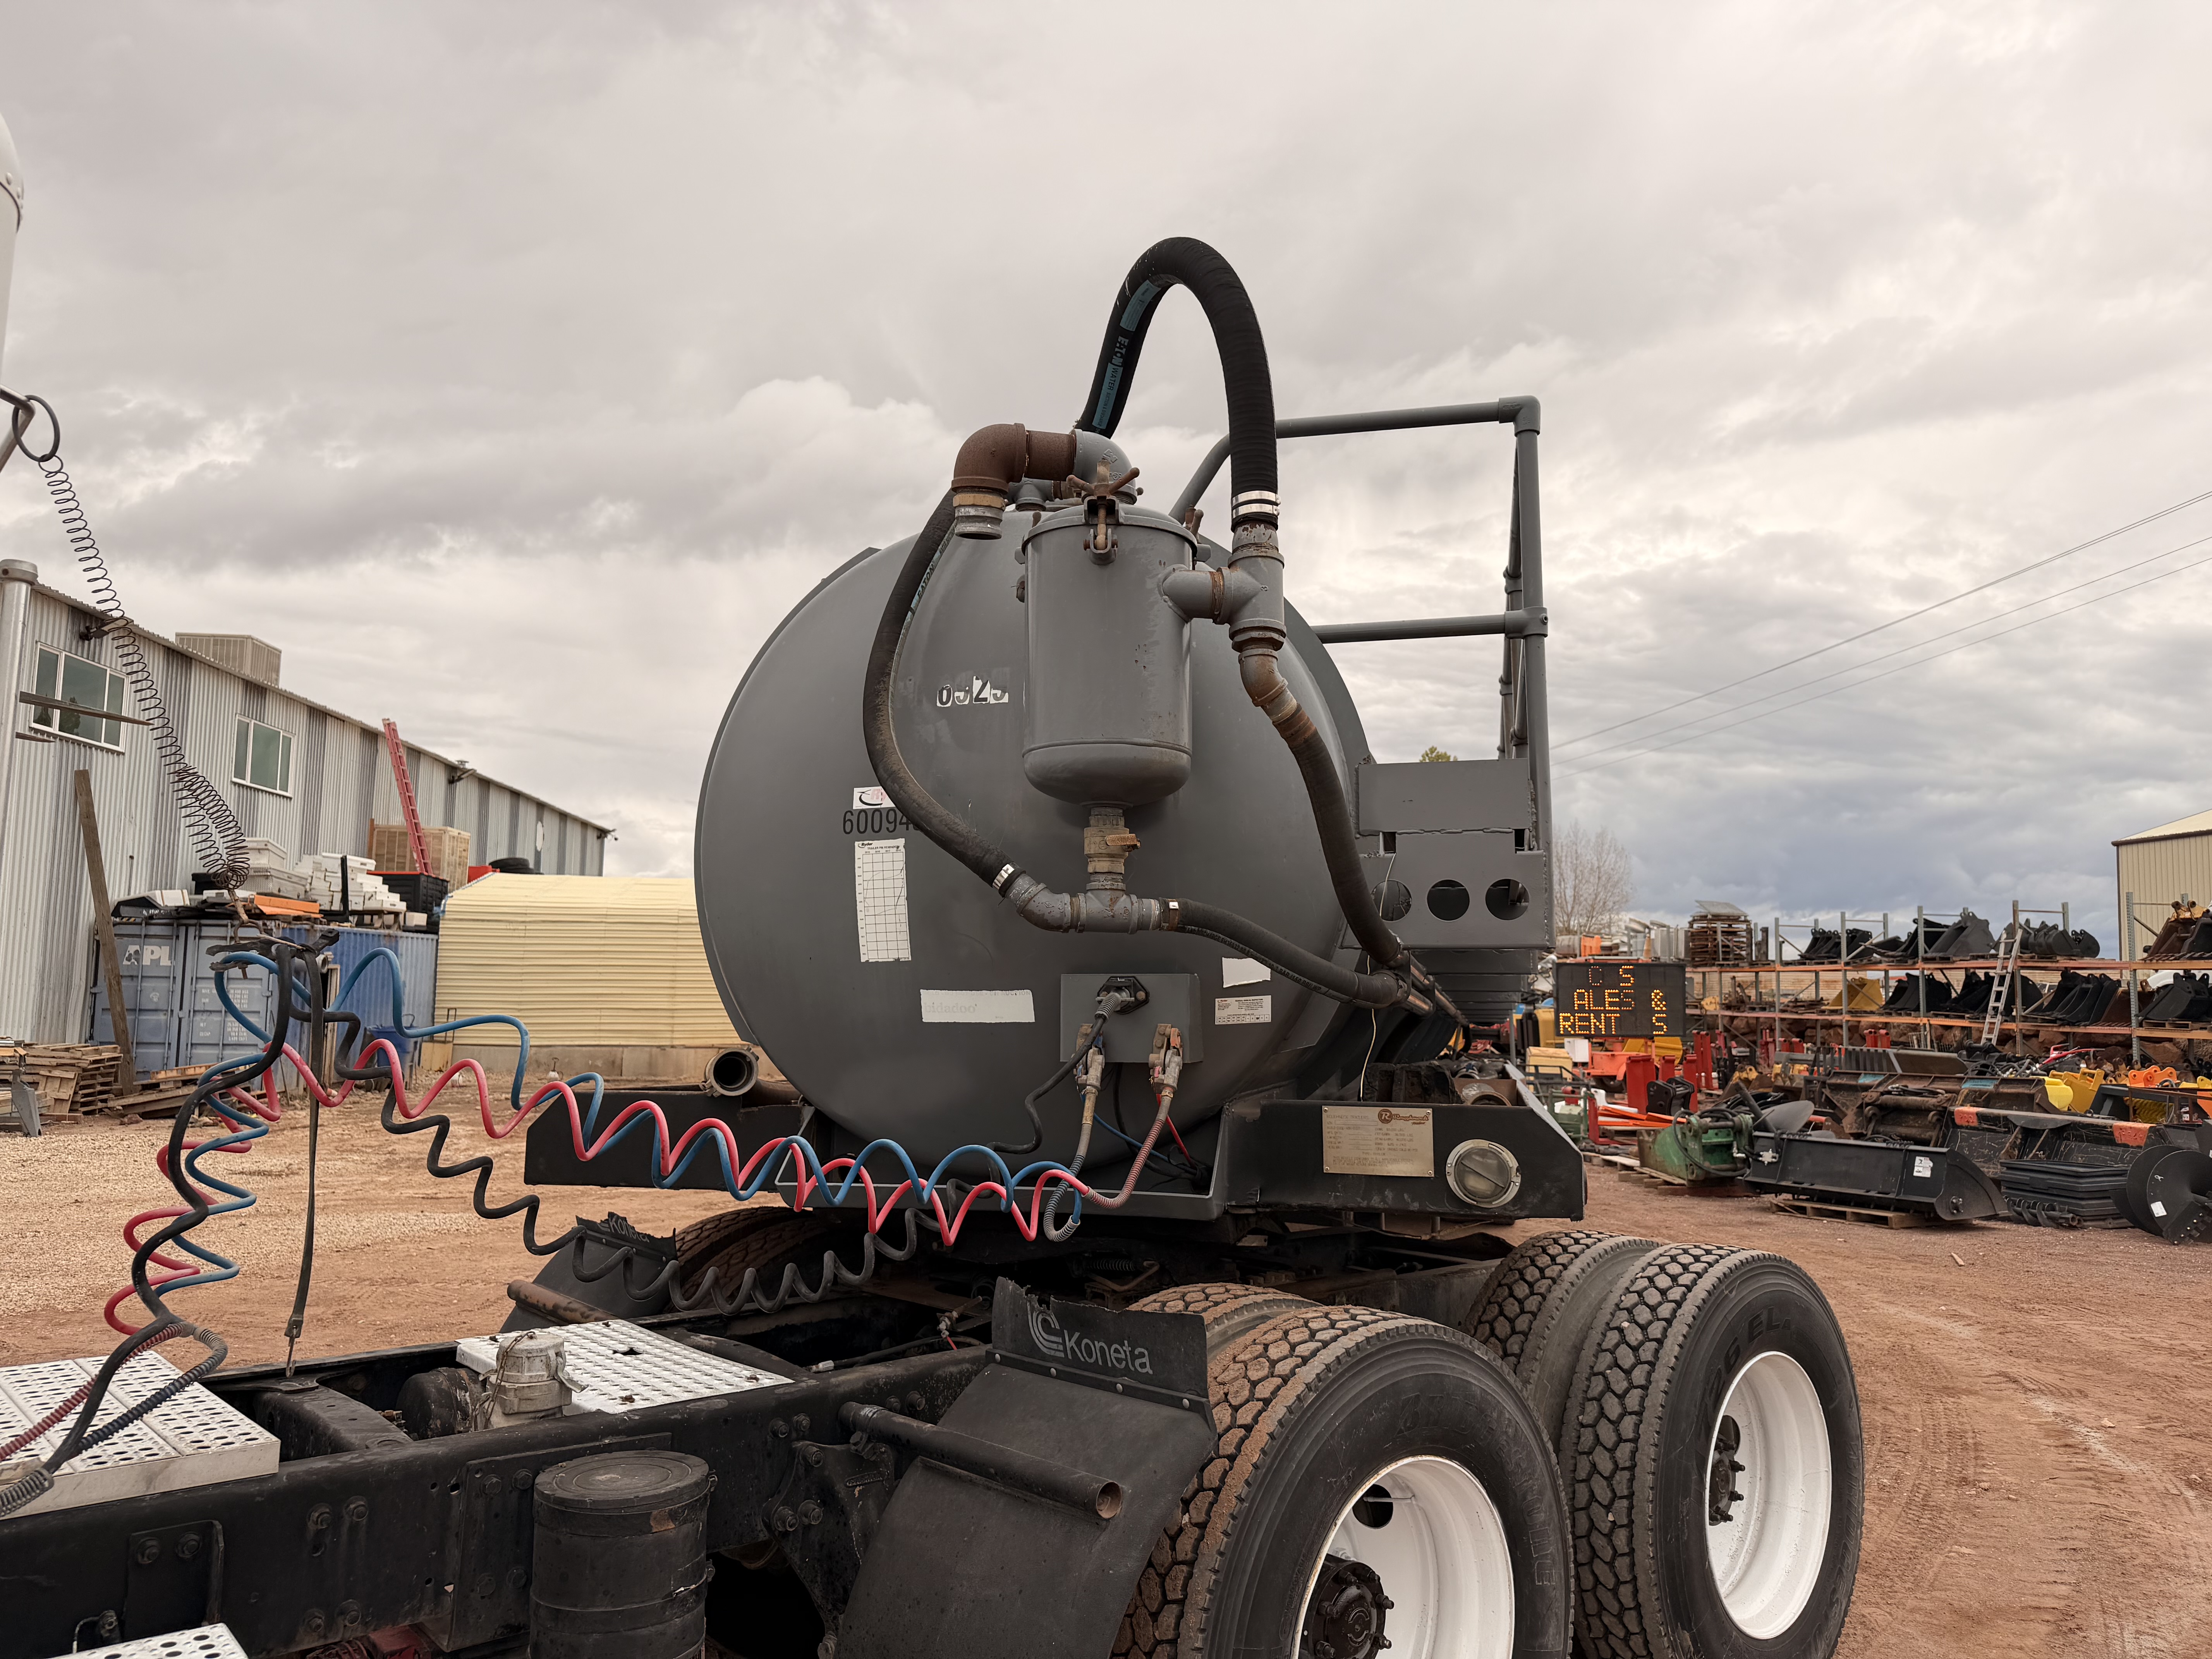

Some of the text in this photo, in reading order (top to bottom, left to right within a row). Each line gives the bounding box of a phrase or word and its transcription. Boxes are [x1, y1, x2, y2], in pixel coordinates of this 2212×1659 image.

[1107, 368, 1119, 391] WATER
[843, 808, 919, 835] 60094
[122, 945, 175, 966] APL
[923, 1002, 976, 1013] bidadoo
[1651, 989, 1667, 1010] &
[1063, 1329, 1153, 1375] Koneta
